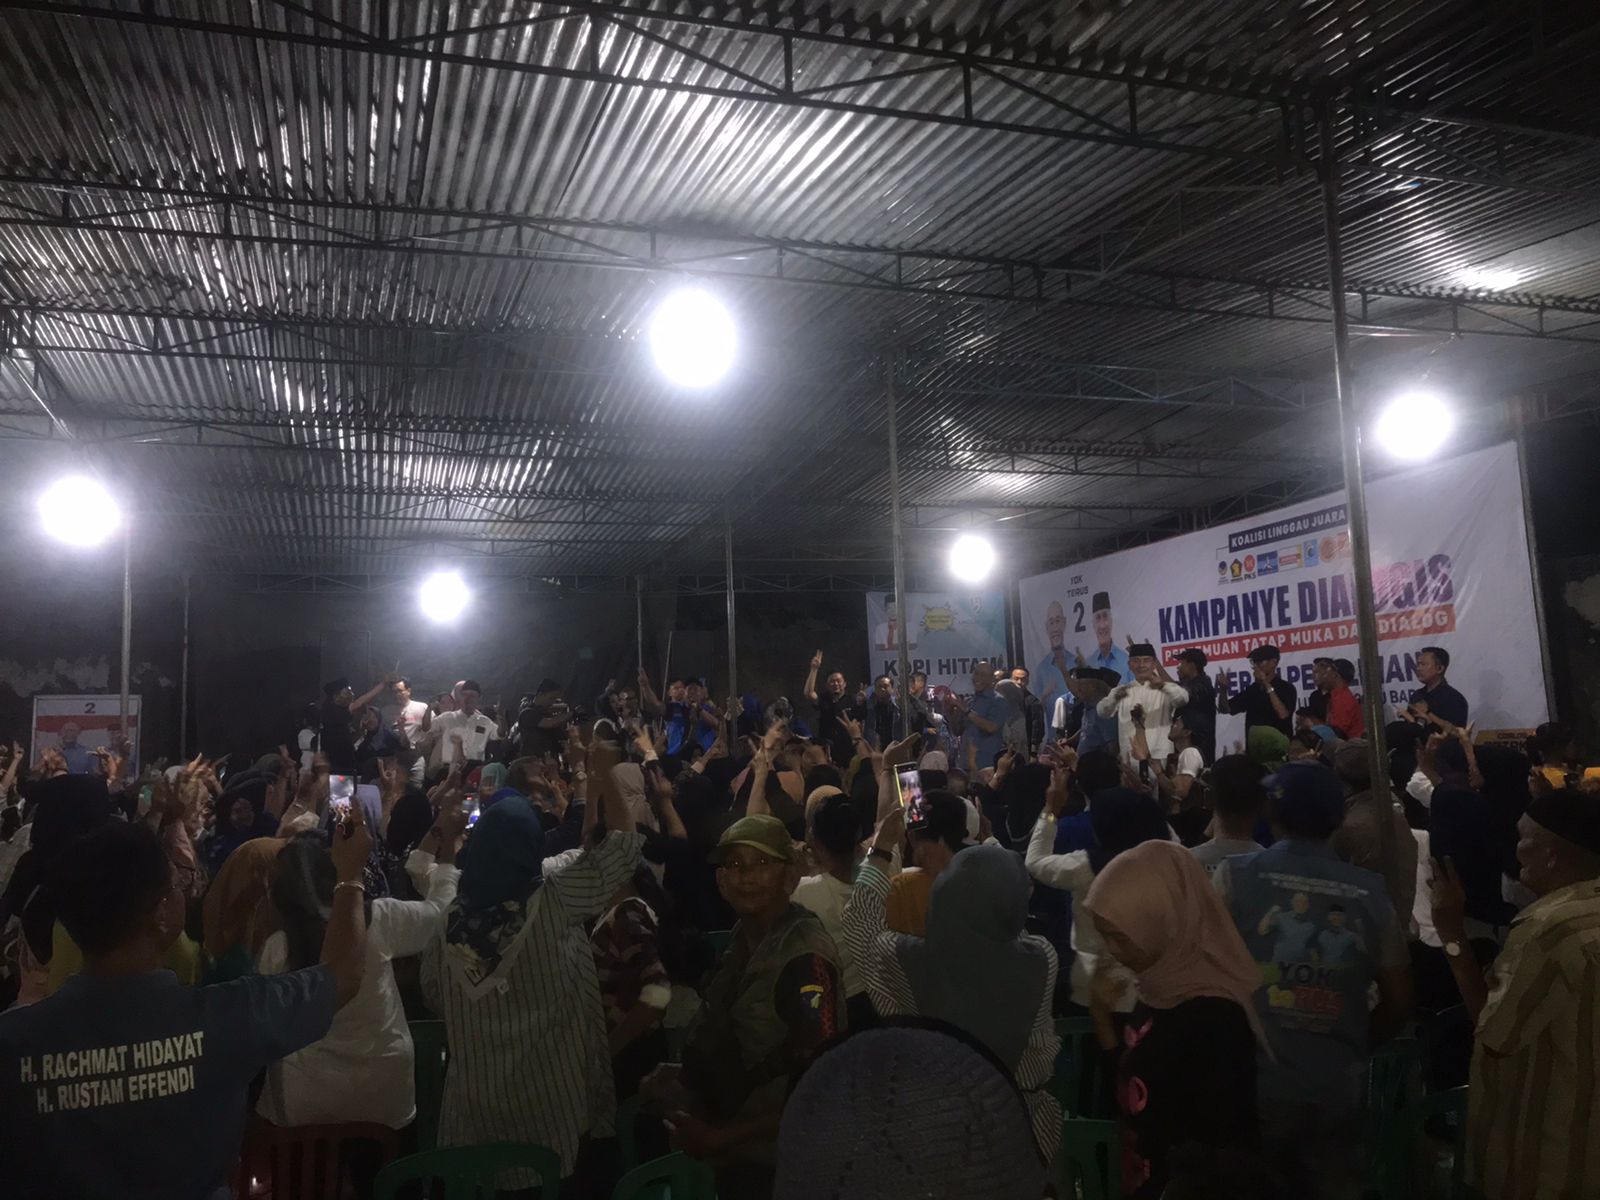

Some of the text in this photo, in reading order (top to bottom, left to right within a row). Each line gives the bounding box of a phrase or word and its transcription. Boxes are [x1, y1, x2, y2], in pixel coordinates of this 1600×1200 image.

[1231, 509, 1347, 548] KOALISI LINGGAU JUARA
[1066, 586, 1089, 598] TERUS
[1244, 573, 1257, 582] PKS
[1073, 601, 1087, 633] 2
[1158, 553, 1454, 644] KAMPANYE DIAGIS
[1165, 641, 1240, 662] PERMUAN
[1290, 630, 1334, 646] MUKA
[1379, 610, 1448, 634] DIALOG
[84, 702, 97, 714] 2
[20, 1031, 204, 1083] H. RACHMAT HIDAYAT
[37, 1065, 196, 1113] H. RUSTAM EFFENDI
